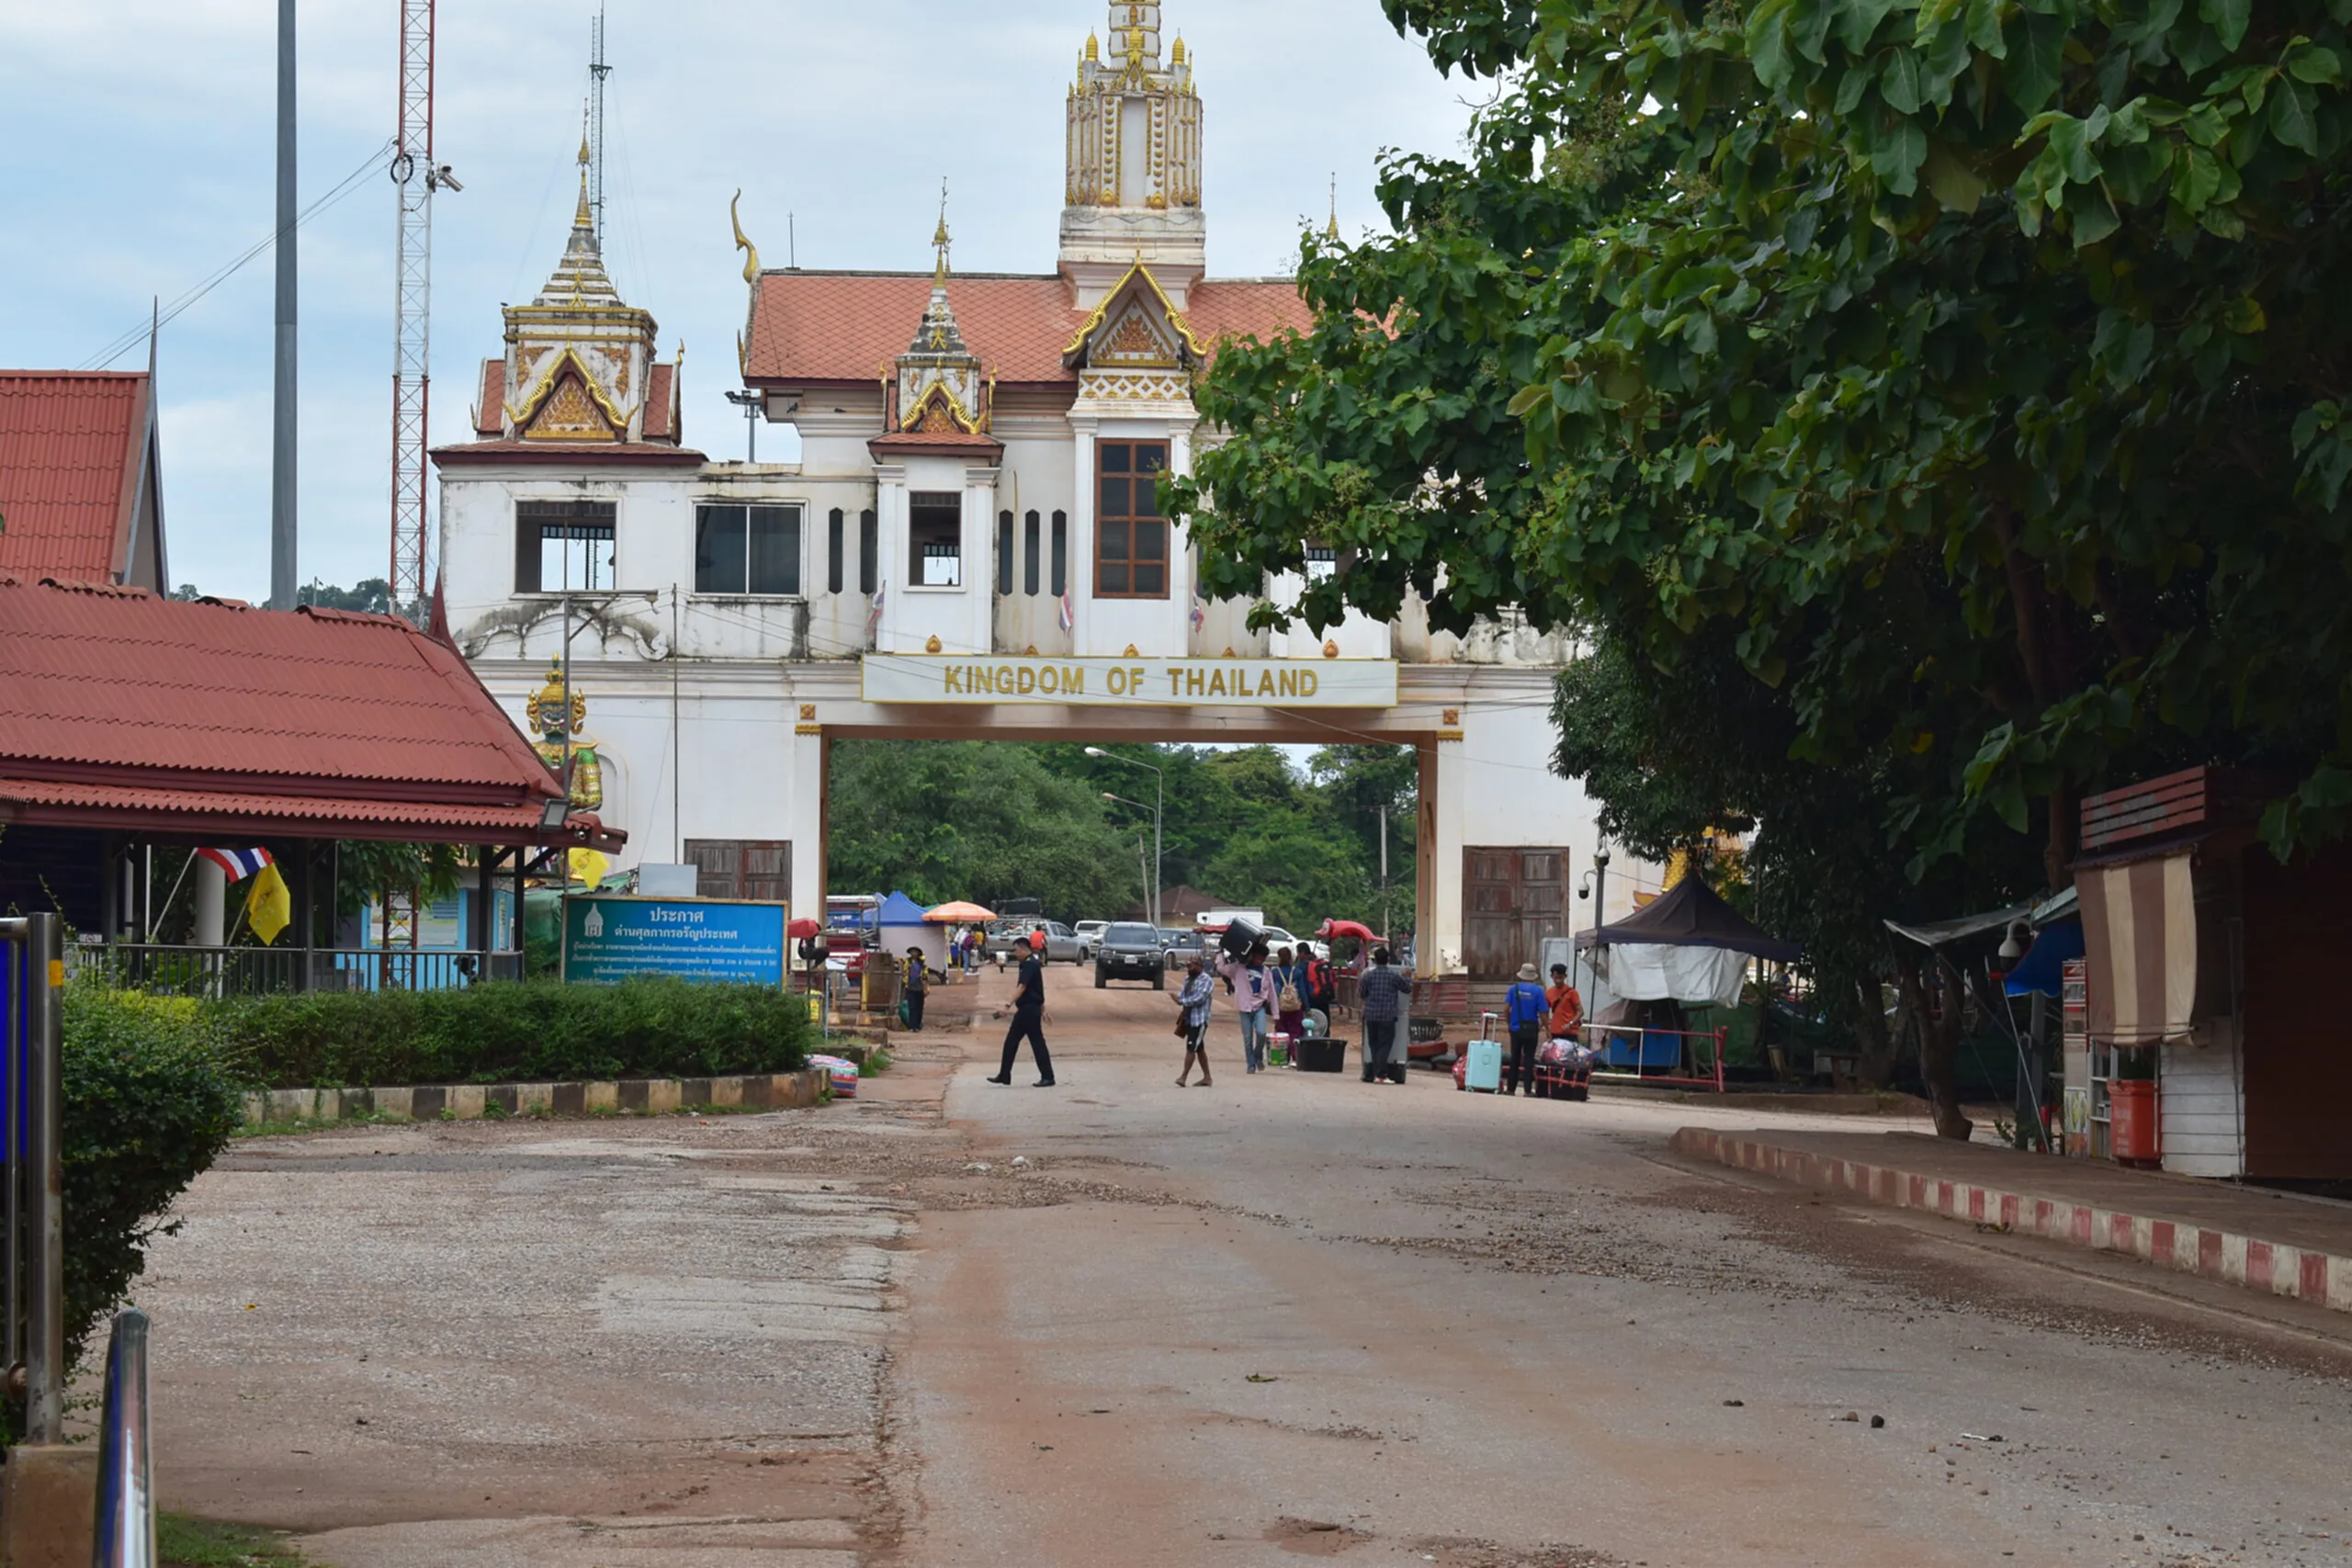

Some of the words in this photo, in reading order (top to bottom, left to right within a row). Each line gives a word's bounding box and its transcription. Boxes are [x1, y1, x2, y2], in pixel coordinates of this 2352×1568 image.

[945, 665, 1083, 694] KINGDOM
[1105, 667, 1145, 695] OF
[1167, 668, 1317, 696] THAILAND
[650, 907, 704, 923] ประกาศ
[615, 924, 738, 942] ด่านศุลกากรอรัญประเทศ
